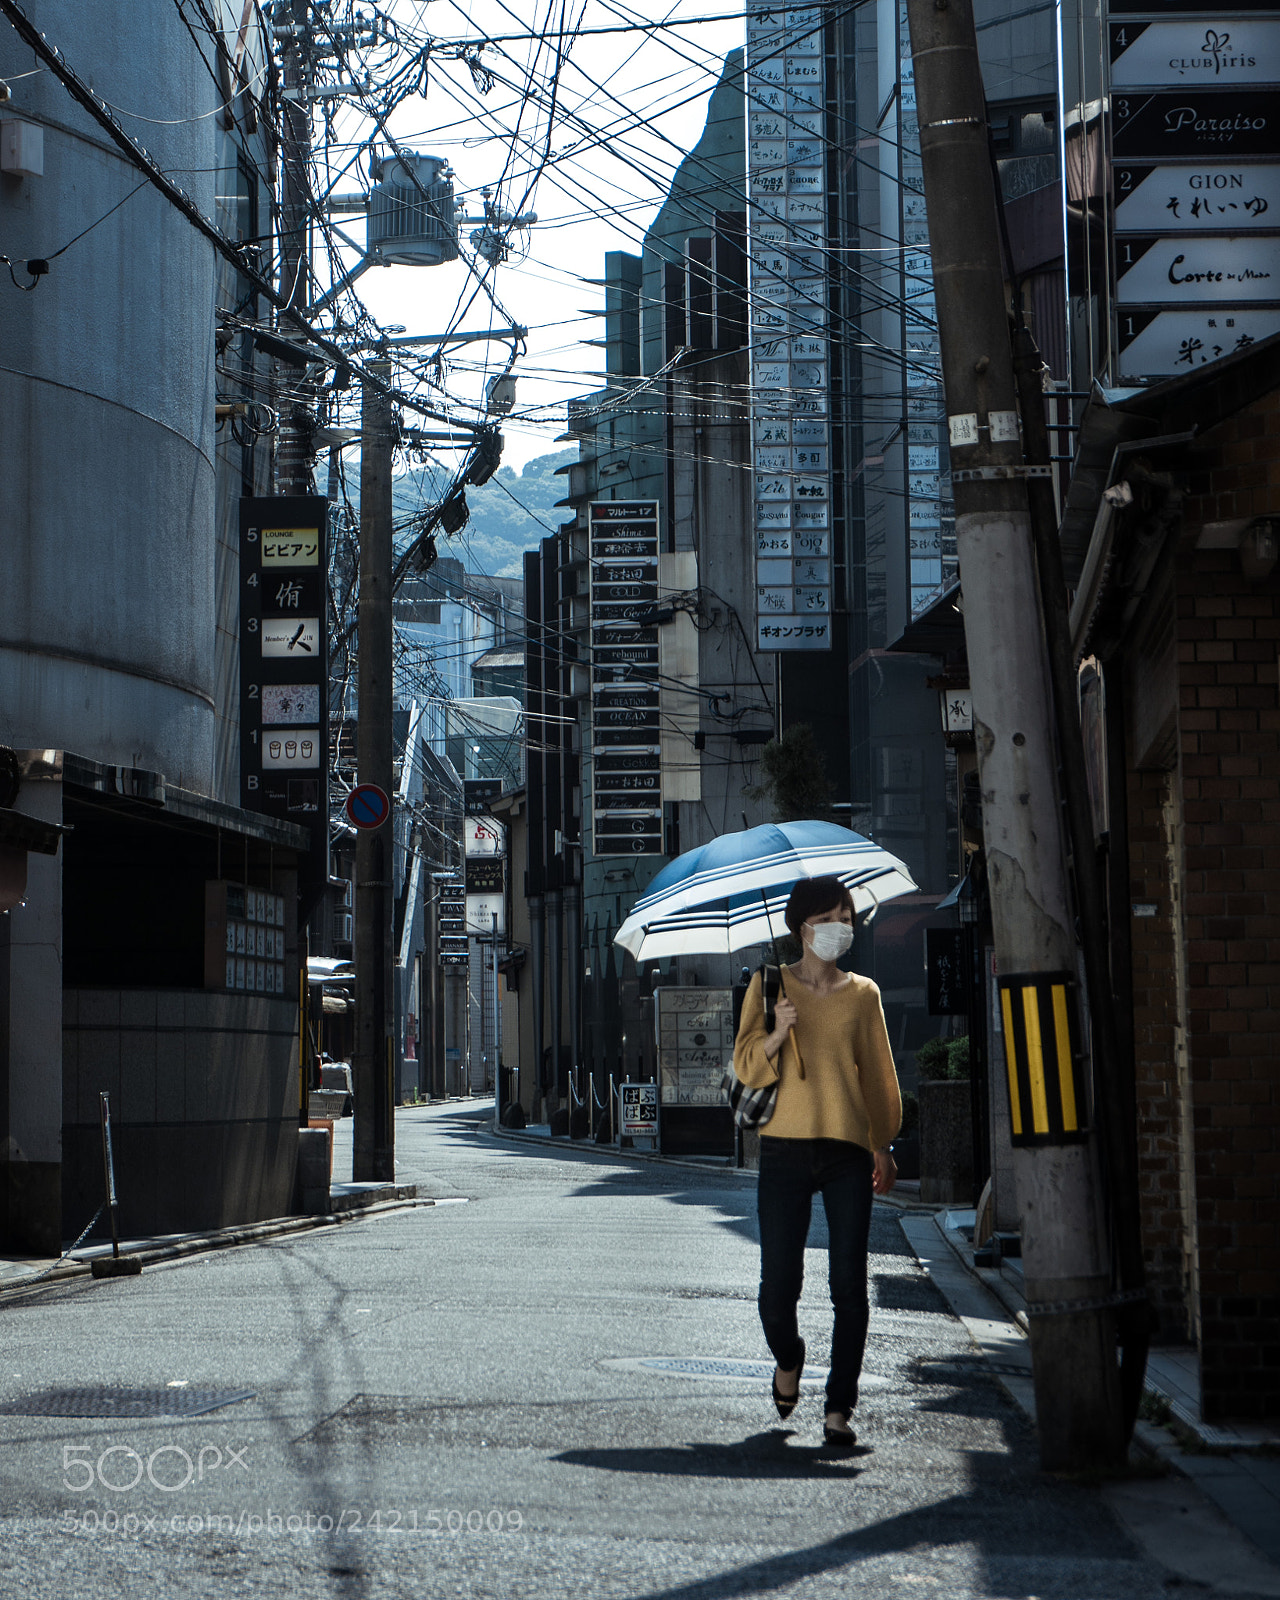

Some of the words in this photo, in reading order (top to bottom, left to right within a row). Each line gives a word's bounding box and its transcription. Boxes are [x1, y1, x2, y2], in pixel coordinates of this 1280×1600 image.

[1115, 28, 1128, 46] 4
[1169, 58, 1213, 68] CLUB
[1222, 53, 1256, 68] iris
[787, 67, 818, 76] しまむら
[1118, 99, 1130, 118] 3
[1164, 107, 1266, 132] Paraiso
[1120, 171, 1132, 190] 2
[1189, 174, 1244, 189] GION
[1166, 196, 1268, 219] それいゆ
[1123, 245, 1133, 263] 1
[1168, 254, 1222, 284] Corte
[1126, 317, 1135, 336] 1
[1207, 318, 1235, 328] 祇園
[795, 511, 825, 520] Cougar
[247, 528, 258, 543] 5
[264, 544, 317, 557] ビビアン
[759, 539, 789, 550] かおる
[247, 572, 259, 587] 4
[609, 586, 641, 598] GOLD
[764, 594, 786, 610] 水咲
[805, 592, 825, 609] さち
[248, 618, 258, 633] 3
[761, 625, 827, 638] ギオンプラザ
[612, 649, 649, 660] rebound
[248, 684, 258, 698] 2
[609, 697, 648, 707] CREATION
[609, 711, 648, 722] OCEAN
[249, 730, 258, 744] 1
[248, 775, 258, 790] B
